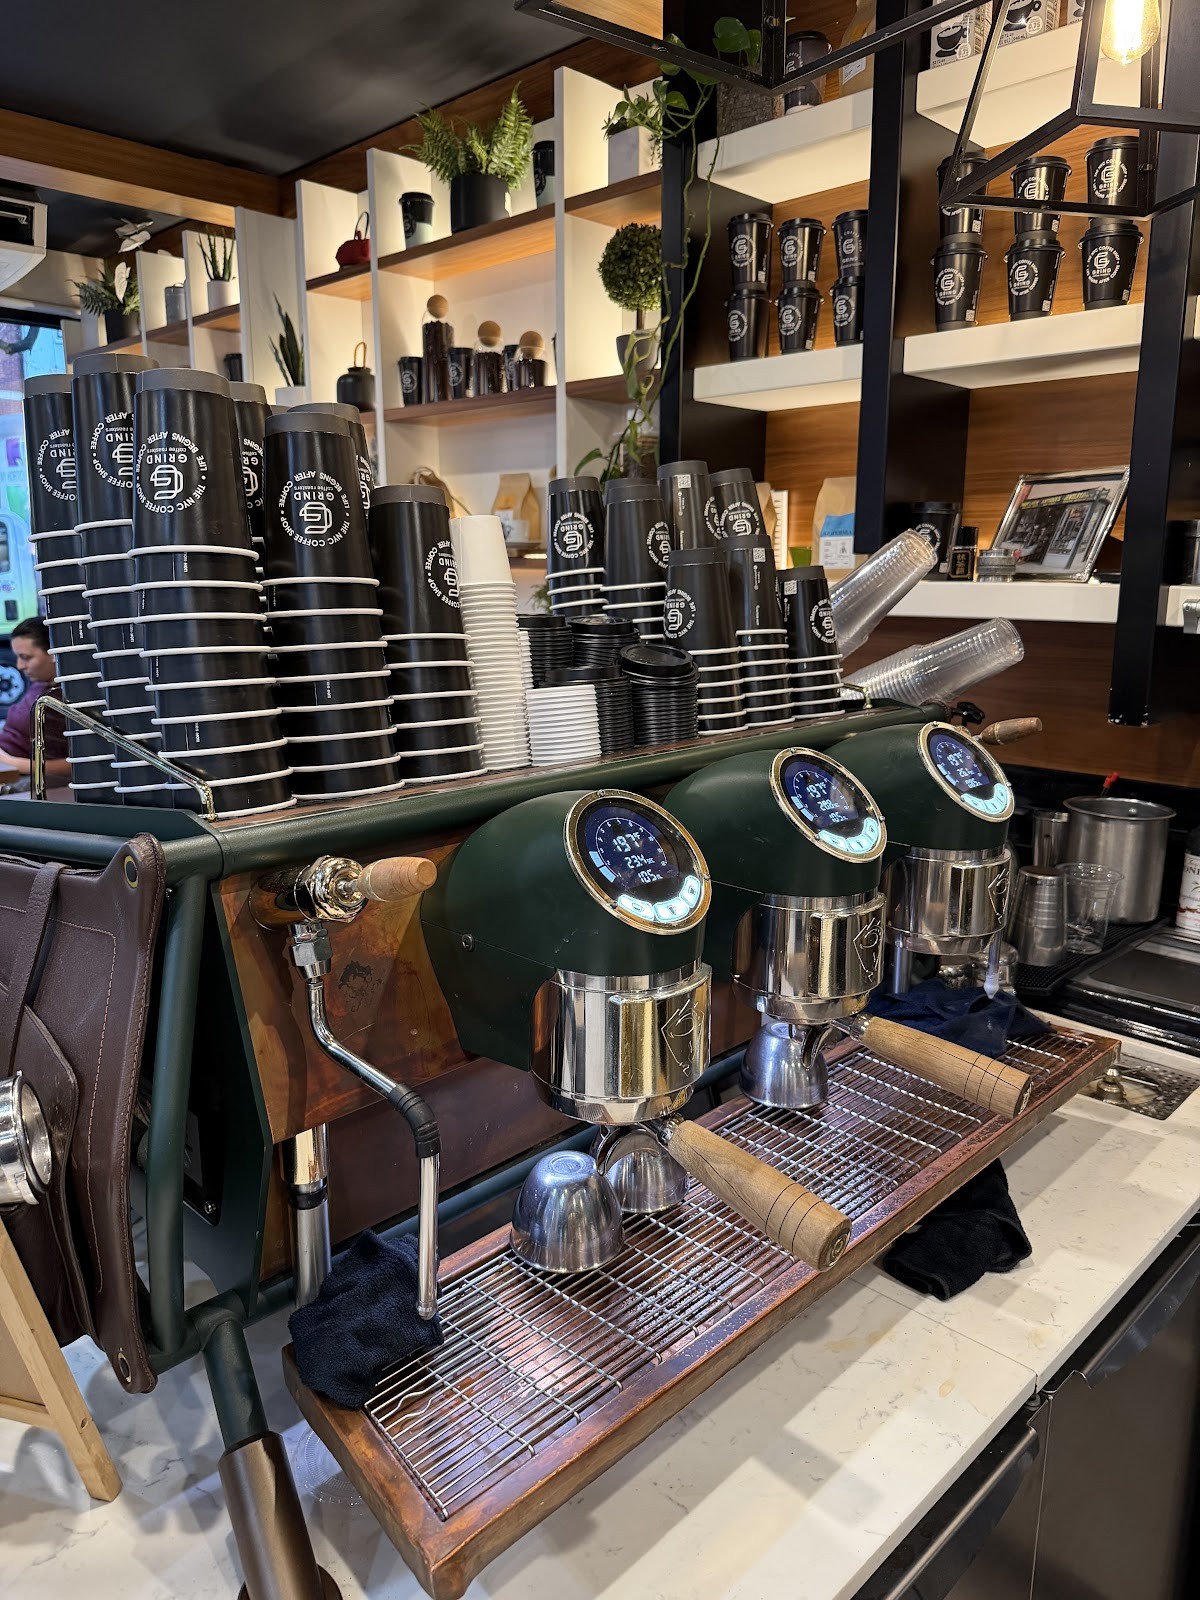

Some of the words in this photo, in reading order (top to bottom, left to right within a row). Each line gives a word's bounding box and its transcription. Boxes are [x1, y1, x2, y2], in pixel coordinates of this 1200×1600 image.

[105, 412, 128, 423] AFTER
[49, 429, 70, 440] AFTER
[90, 422, 104, 450] COFFEE
[147, 431, 168, 444] AFTER
[172, 432, 199, 454] BEGINS
[37, 440, 49, 465] COFFEE
[50, 449, 75, 458] IND
[136, 444, 146, 472] COFFEE
[146, 454, 188, 464] GRIND
[92, 459, 108, 478] SHOP
[196, 455, 208, 471] LIFE
[40, 474, 53, 492] SHOP
[107, 476, 133, 488] OFFEE
[294, 470, 316, 482] AFTER
[320, 472, 342, 492] BEGINS
[52, 490, 76, 500] OFFEE
[136, 482, 146, 503] SHOP
[192, 484, 206, 500] THE
[278, 481, 294, 508] COFFEE
[294, 492, 334, 502] GRIND
[144, 500, 174, 514] COFFEE
[176, 496, 196, 510] NYC
[340, 494, 350, 508] LIFE
[728, 512, 751, 521] GRIND
[280, 516, 294, 536] SHOP
[340, 520, 350, 534] THE
[560, 524, 584, 532] GRIND
[294, 534, 326, 546] COFFEE
[328, 532, 344, 544] NYC
[424, 546, 438, 570] COFFEE
[428, 578, 442, 597] SHOP
[678, 628, 688, 637] NYC
